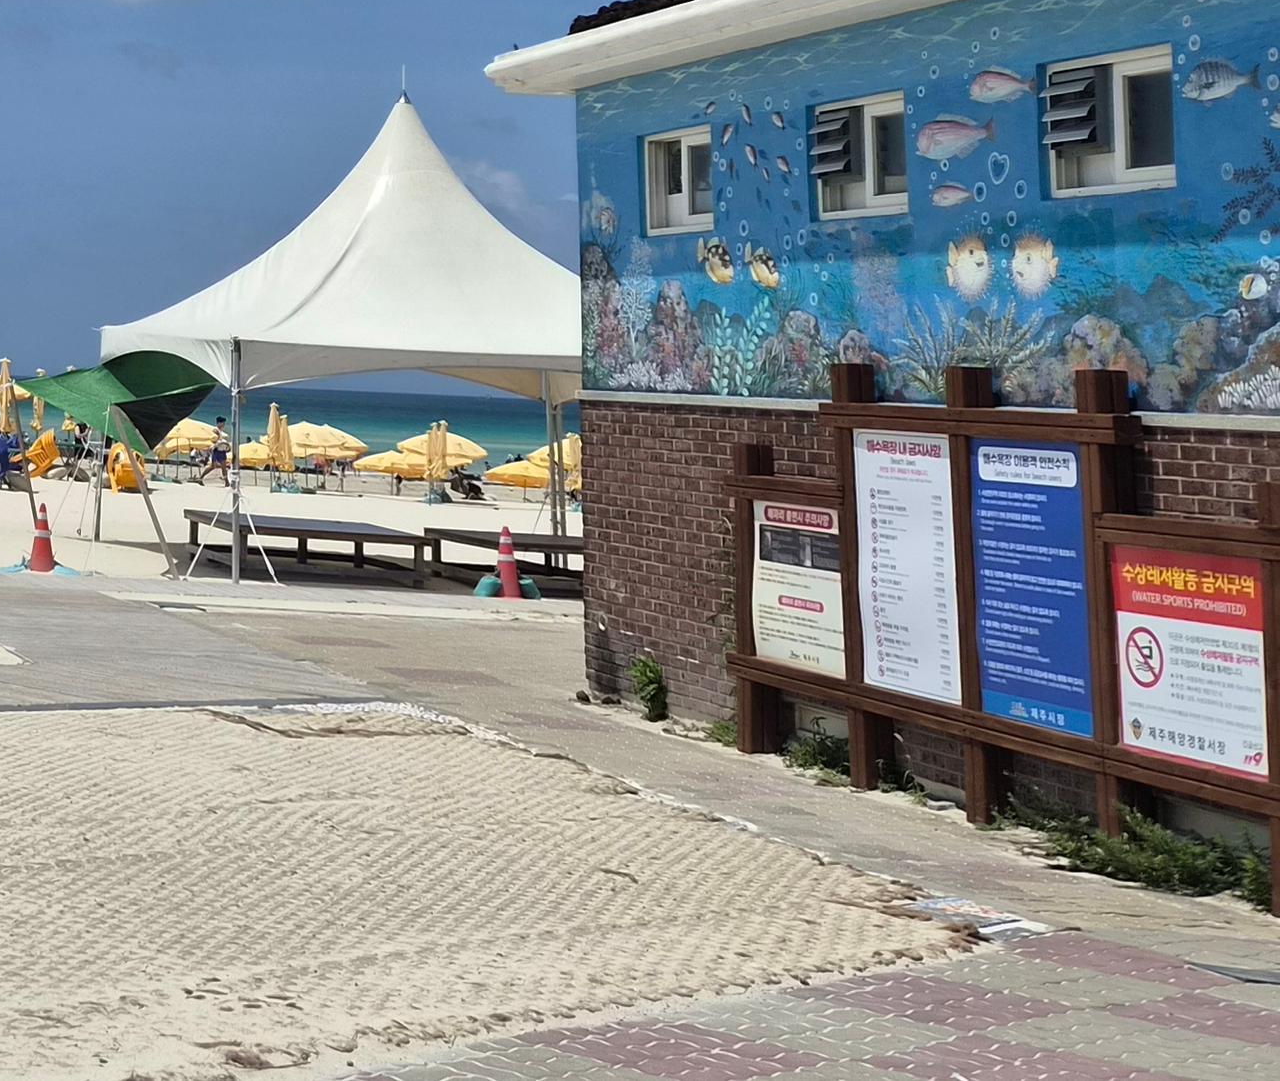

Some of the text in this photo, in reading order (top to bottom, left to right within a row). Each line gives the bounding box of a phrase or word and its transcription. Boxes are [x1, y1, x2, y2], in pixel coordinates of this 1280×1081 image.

[866, 439, 898, 455] 해수욕장
[908, 443, 942, 459] 금지사항
[982, 453, 1070, 471] 해수욕장 이용객 안전수칙
[1122, 561, 1255, 599] 수상레저활동 금지구역
[1162, 595, 1193, 609] SPORTS
[1194, 598, 1247, 617] PROHIBITED)
[1030, 707, 1065, 726] 제주시장
[1148, 726, 1226, 755] 제주해양경찰서장
